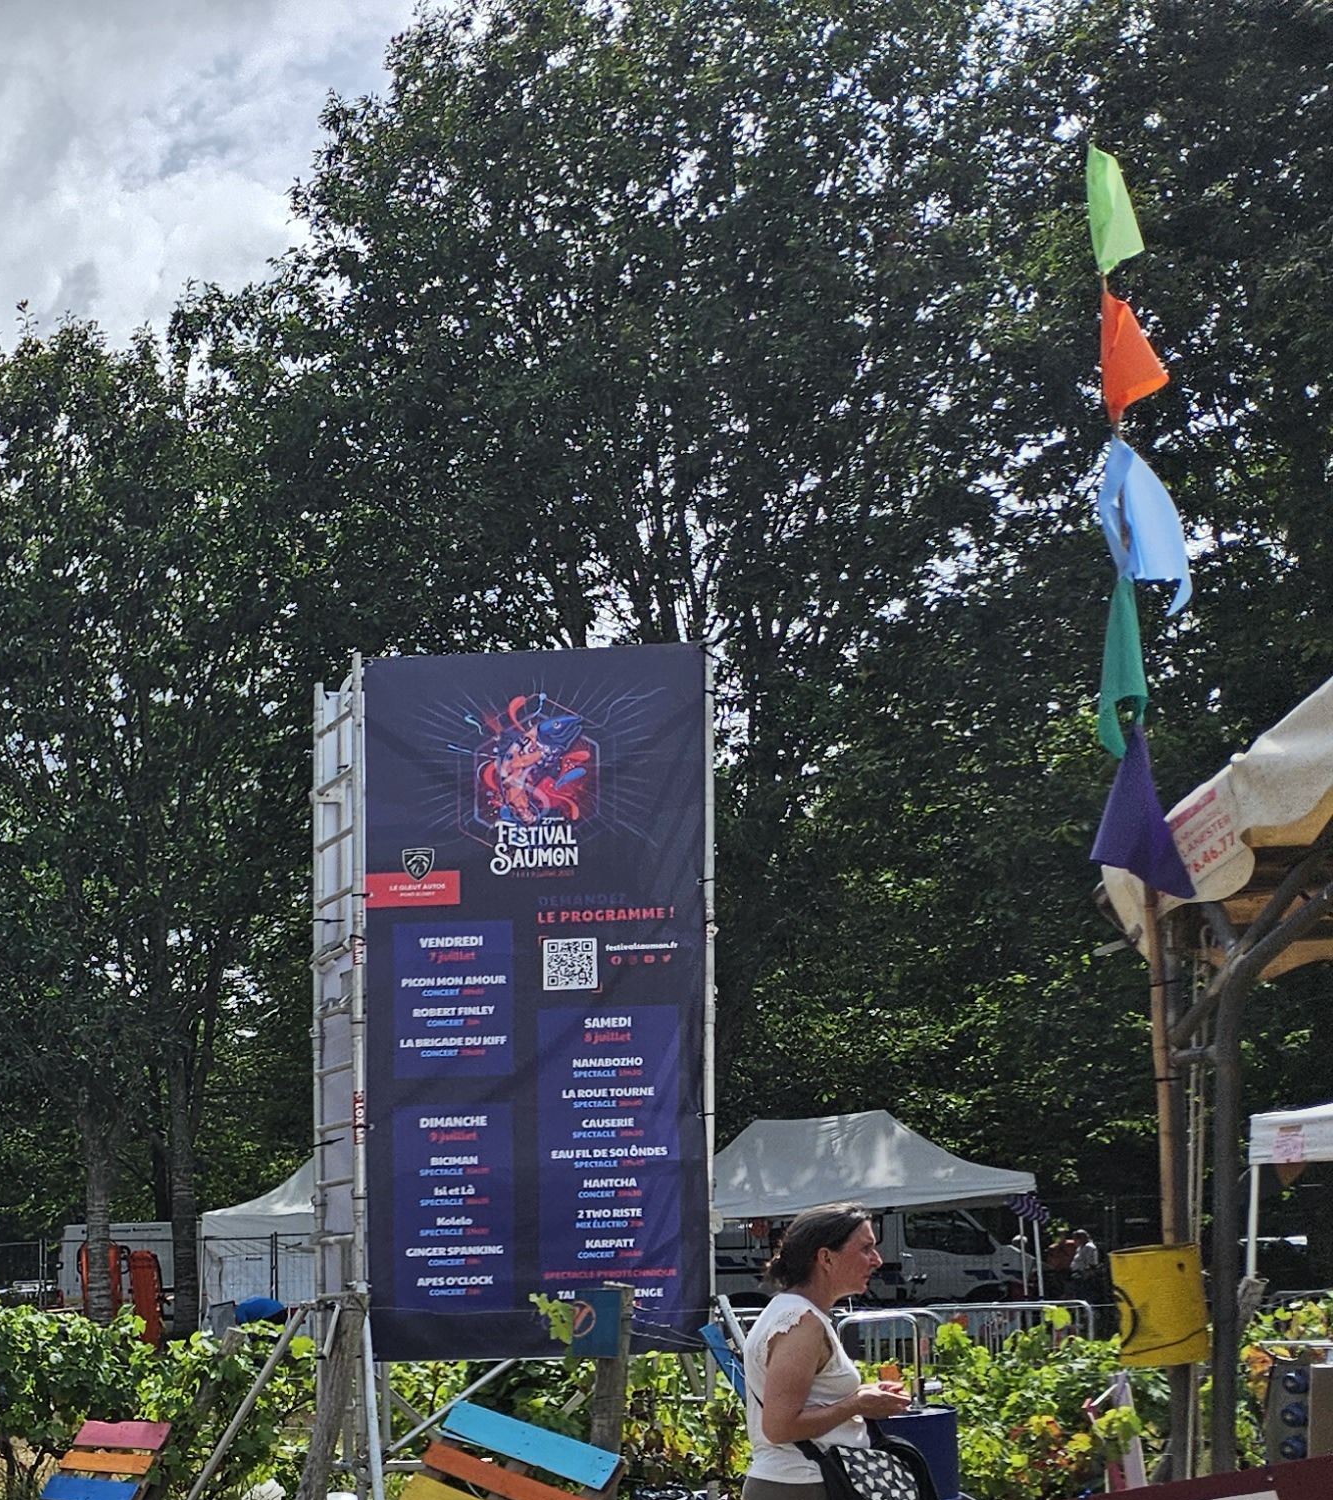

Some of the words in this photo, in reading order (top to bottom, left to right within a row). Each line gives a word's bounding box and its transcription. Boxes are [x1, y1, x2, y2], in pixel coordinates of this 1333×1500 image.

[494, 820, 577, 847] FESTIVAL
[490, 843, 578, 875] SAUMON
[537, 893, 626, 906] DEMANDEZ
[537, 911, 555, 923] LE
[560, 907, 665, 922] PROGRAMME
[669, 906, 675, 918] !
[419, 935, 483, 948] VENDREDI
[437, 951, 476, 964] juillet
[401, 978, 435, 988] PICON
[436, 976, 463, 986] MON
[464, 975, 507, 985] AMOUR
[421, 988, 460, 996] CONCERT
[412, 1007, 456, 1017] ROBERT
[457, 1005, 495, 1016] FINLEY
[426, 1019, 465, 1027] CONCERT
[584, 1016, 632, 1029] SAMEDI
[399, 1039, 414, 1048] LA
[415, 1037, 464, 1047] BRIGADE
[465, 1036, 481, 1045] DU
[482, 1035, 508, 1045] KIFF
[592, 1031, 631, 1044] juillet
[420, 1049, 459, 1057] CONCERT
[572, 1057, 644, 1068] NANABOZHO
[573, 1069, 617, 1078] SPECTACLE
[562, 1089, 576, 1099] LA
[577, 1088, 608, 1098] ROUE
[609, 1086, 655, 1097] TOURNE
[573, 1100, 617, 1109] SPECTACLE
[419, 1115, 488, 1128] DIMANCHE
[582, 1117, 634, 1128] CAUSERIE
[439, 1131, 477, 1144] juillet
[572, 1130, 616, 1139] SPECTACLE
[551, 1149, 574, 1160] EAU
[575, 1149, 592, 1159] FIL
[593, 1148, 609, 1158] DE
[610, 1147, 628, 1157] SOI
[629, 1144, 668, 1157] ÔNDES
[430, 1156, 478, 1166] BICIMAN
[573, 1160, 618, 1168] SPECTACLE
[419, 1168, 463, 1176] SPECTACLE
[583, 1177, 637, 1188] HANTCHA
[448, 1187, 460, 1196] et
[461, 1184, 475, 1195] Là
[578, 1190, 616, 1199] CONCERT
[420, 1198, 463, 1207] SPECTACLE
[577, 1210, 586, 1219] 2
[586, 1209, 612, 1218] TWO
[612, 1208, 643, 1218] RISTE
[575, 1221, 592, 1229] MIX
[592, 1219, 629, 1229] ÉLECTRO
[419, 1228, 463, 1237] SPECTACLE
[585, 1238, 635, 1249] KARPATT
[405, 1246, 447, 1258] GINGER
[447, 1245, 504, 1256] SPANKING
[577, 1251, 615, 1259] CONCERT
[428, 1258, 466, 1267] CONCERT
[416, 1276, 445, 1287] APES
[446, 1275, 493, 1287] O'CLOCK
[429, 1288, 467, 1296] CONCERT
